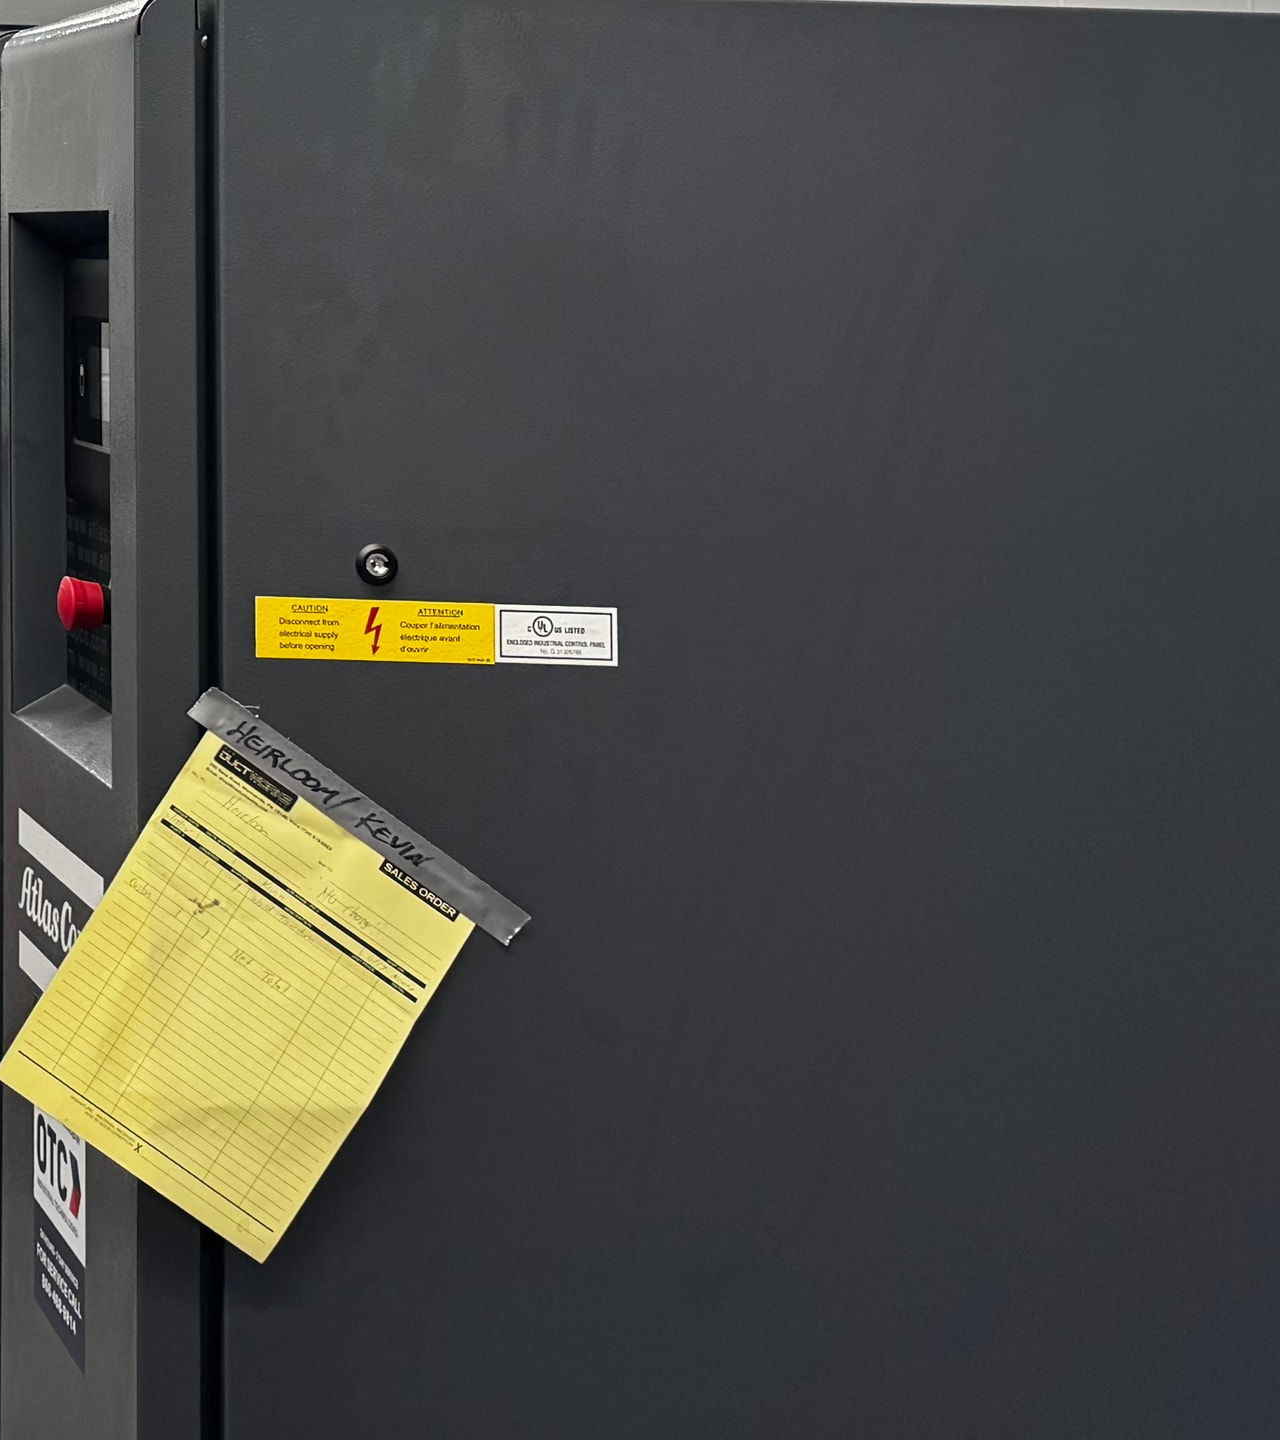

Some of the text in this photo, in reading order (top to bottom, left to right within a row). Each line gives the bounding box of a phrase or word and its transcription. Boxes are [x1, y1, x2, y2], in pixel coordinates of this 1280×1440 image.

[292, 604, 328, 613] CAUTION
[418, 608, 464, 616] ATTENTION
[279, 617, 320, 626] Disconnect
[400, 621, 480, 630] Couper l'alimentation
[314, 632, 338, 640] supply
[305, 644, 334, 652] opening
[354, 812, 435, 868] KEVIN
[384, 863, 457, 918] SALES ORDER
[134, 1142, 143, 1154] X
[36, 1112, 68, 1202] OTC
[36, 1242, 82, 1320] FOR SERVICE CALL
